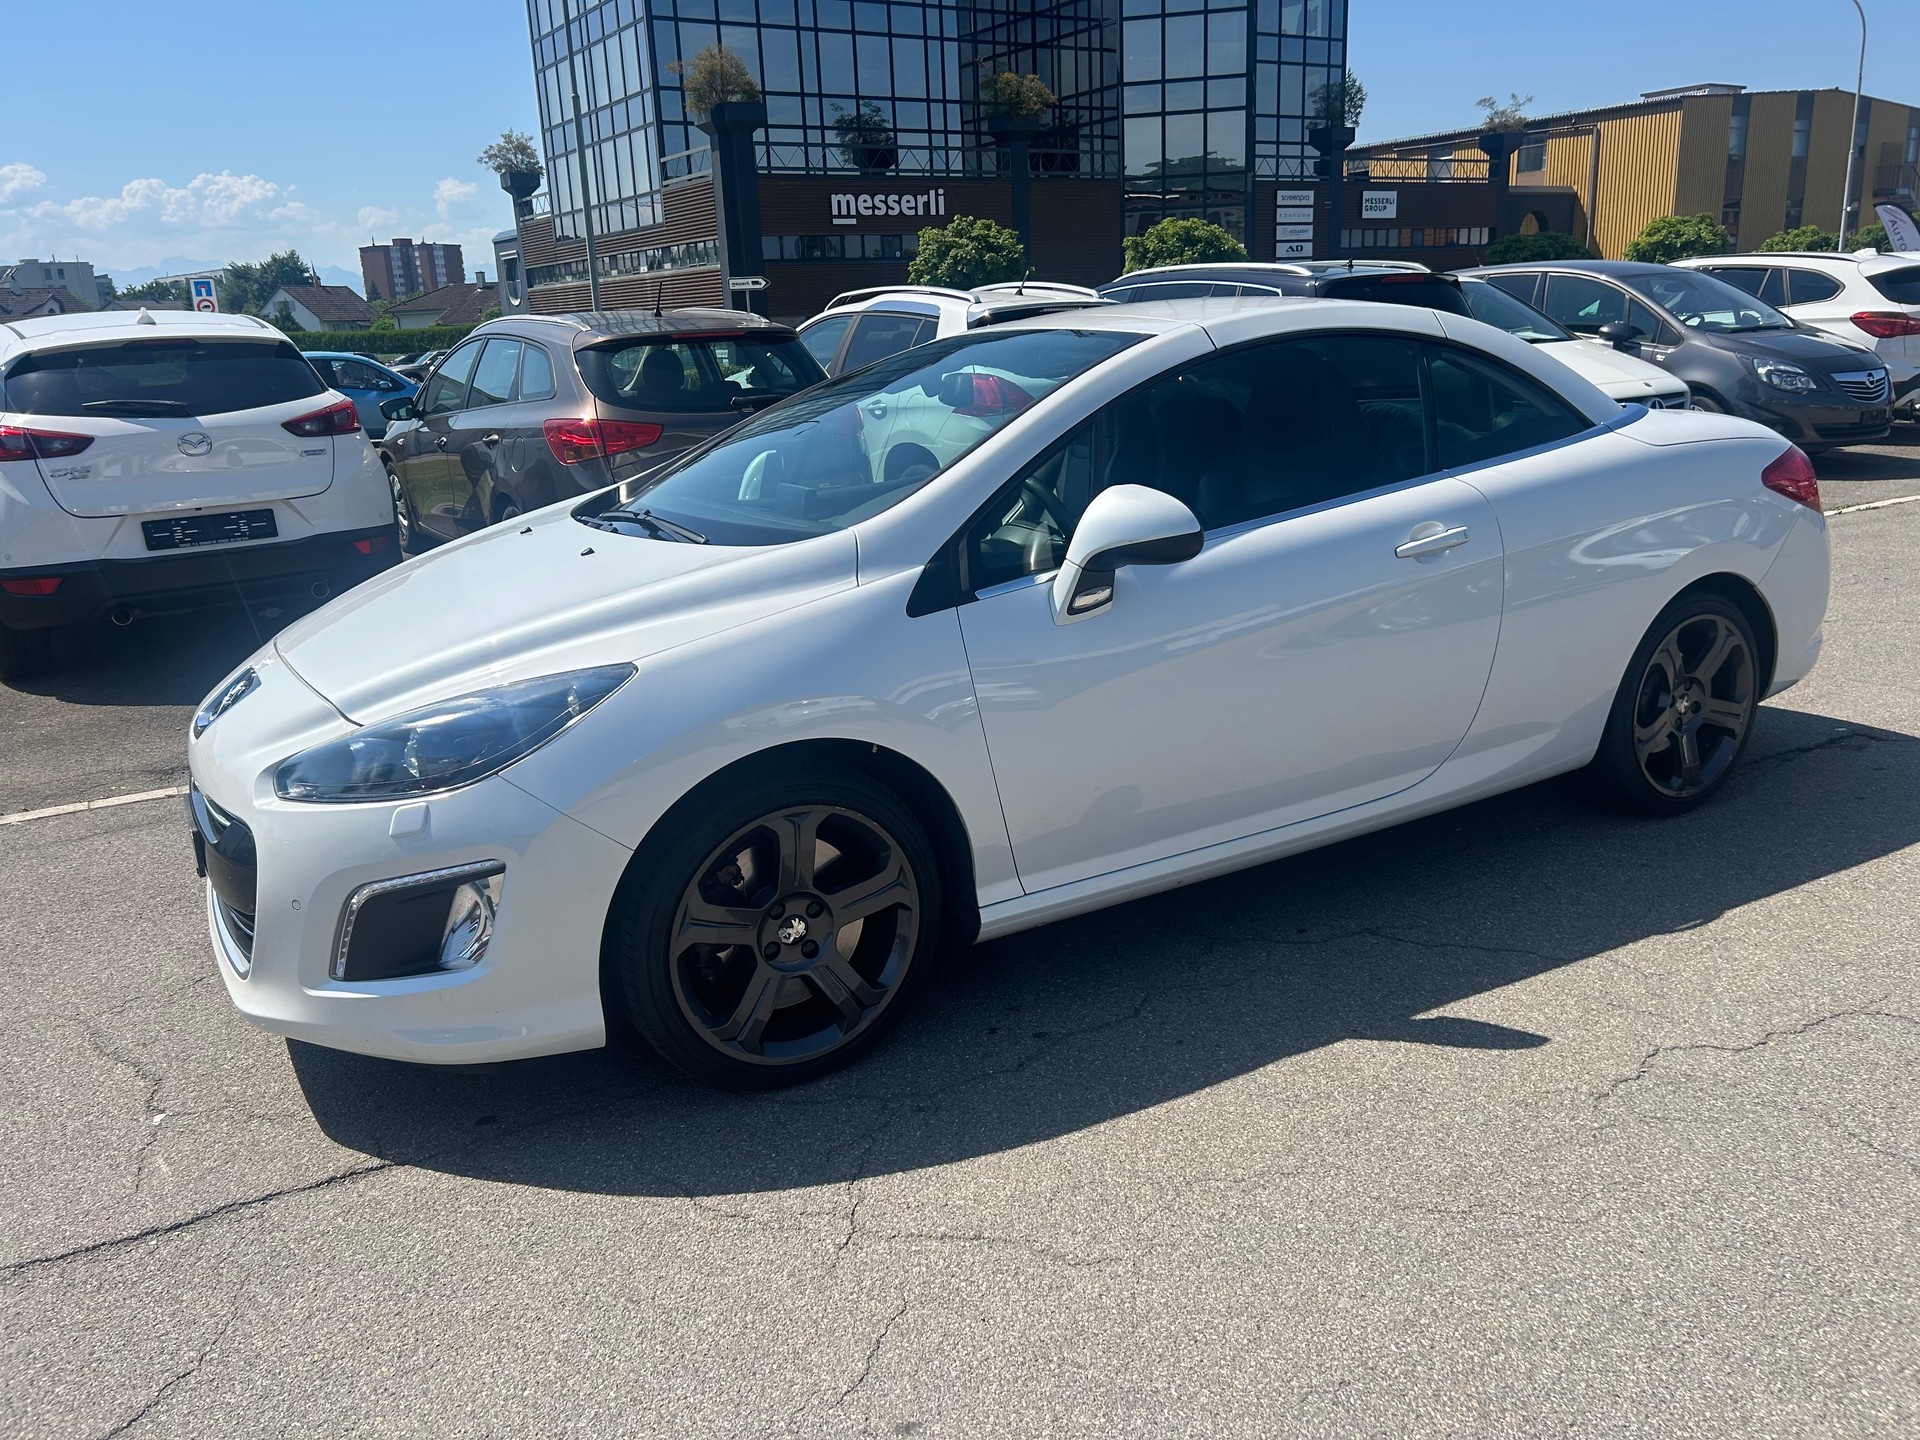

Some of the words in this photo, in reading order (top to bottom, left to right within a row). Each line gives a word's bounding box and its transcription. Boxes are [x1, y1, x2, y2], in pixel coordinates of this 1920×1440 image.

[831, 188, 945, 216] messerli
[1285, 244, 1304, 253] AD
[1889, 220, 1907, 251] AUTO
